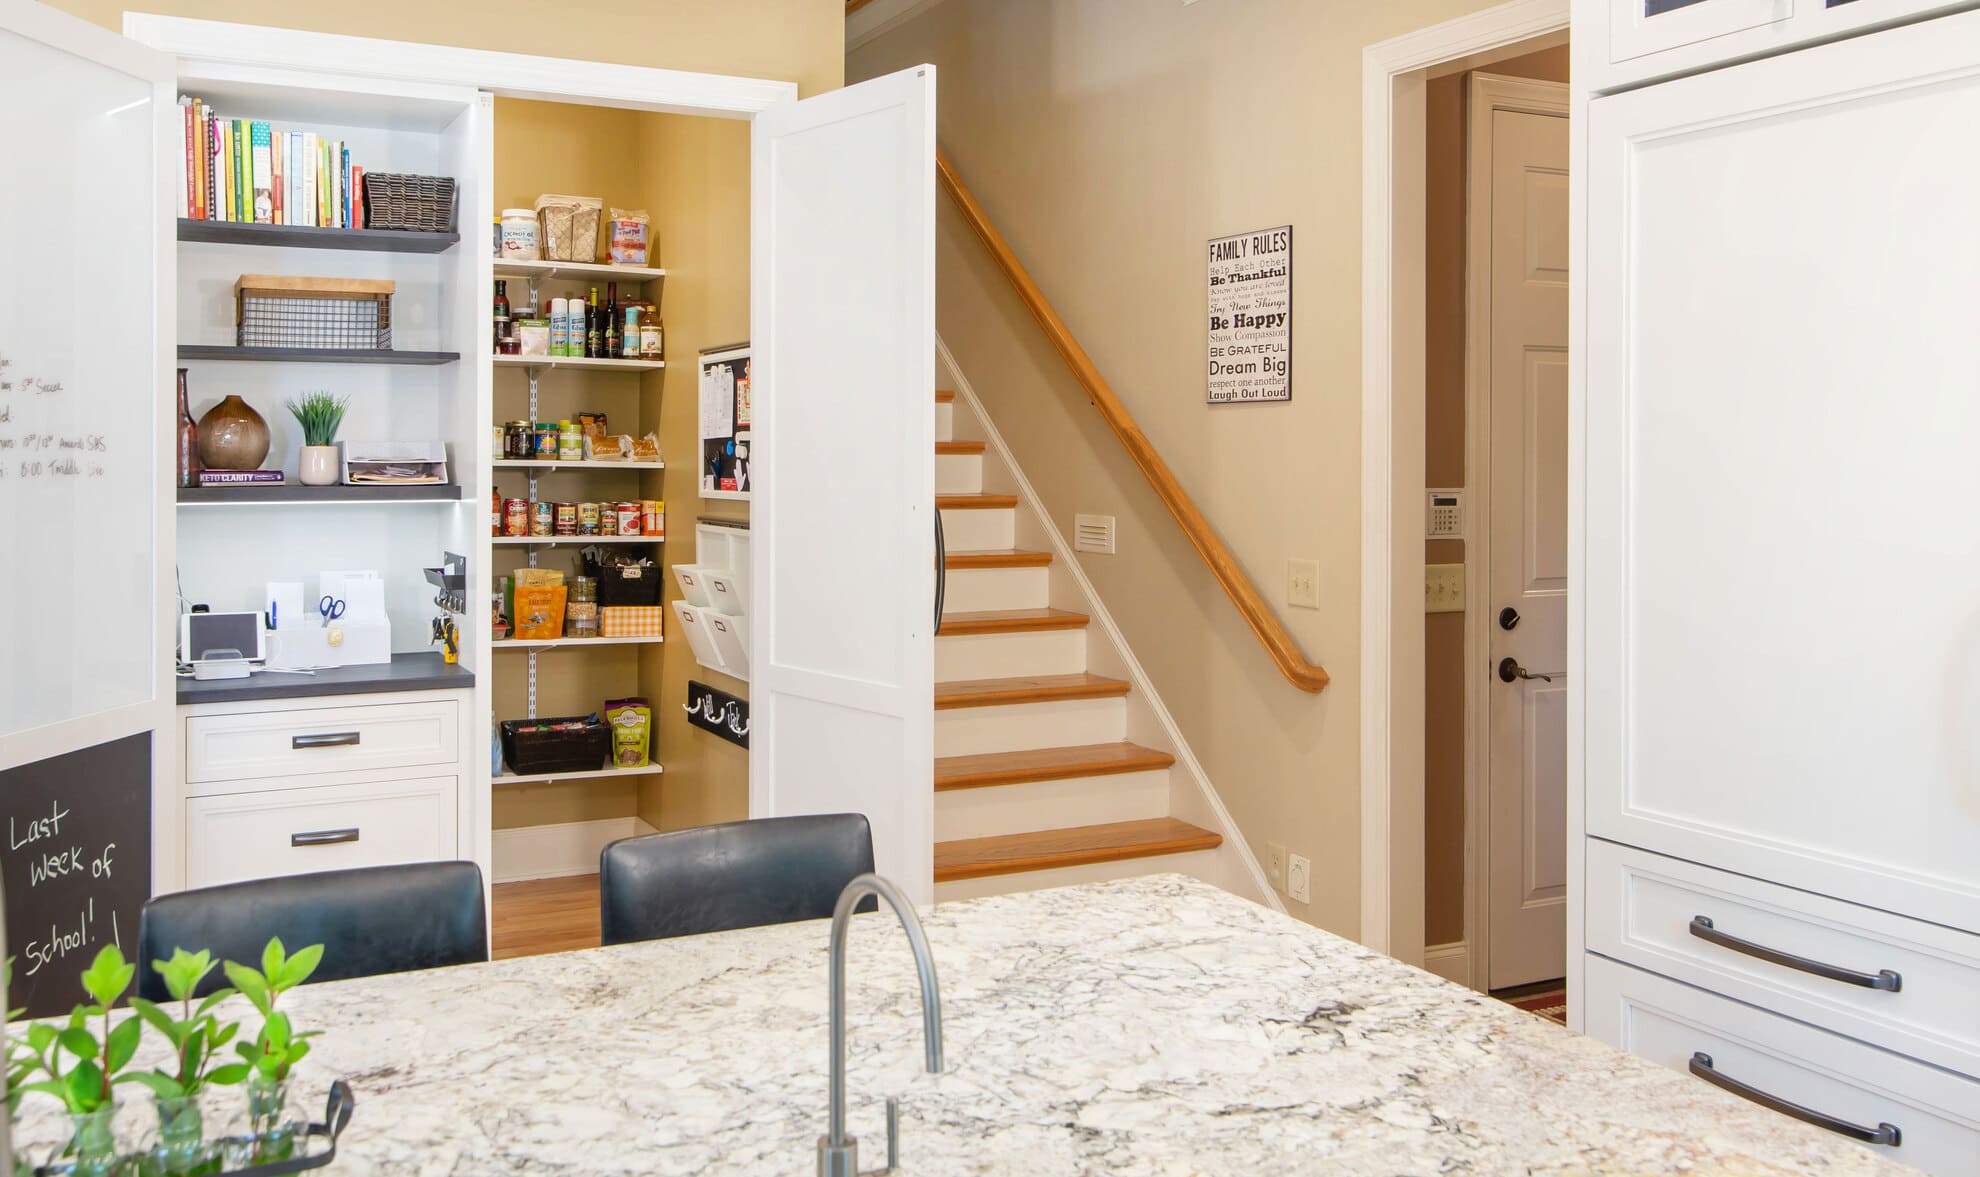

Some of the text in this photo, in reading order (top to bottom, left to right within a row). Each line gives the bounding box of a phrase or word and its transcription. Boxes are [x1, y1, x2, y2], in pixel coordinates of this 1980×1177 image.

[1210, 231, 1287, 263] FAMILY RULES
[1210, 257, 1286, 276] Help Each Other
[1210, 266, 1287, 286] Be Thankful
[1210, 288, 1231, 296] Know
[1265, 279, 1285, 288] loved
[1210, 297, 1286, 315] Try New Things
[1210, 312, 1287, 331] Be Happy
[1210, 328, 1286, 343] Show Compassion
[1210, 343, 1287, 357] BE GRATEFUL
[1209, 356, 1286, 376] Dream Big
[1209, 375, 1286, 390] respect one another
[1209, 386, 1286, 401] Laugh Out Loud
[200, 474, 220, 482] KETO
[221, 474, 254, 482] CLARITY
[10, 800, 70, 850] Last
[92, 843, 116, 879] of
